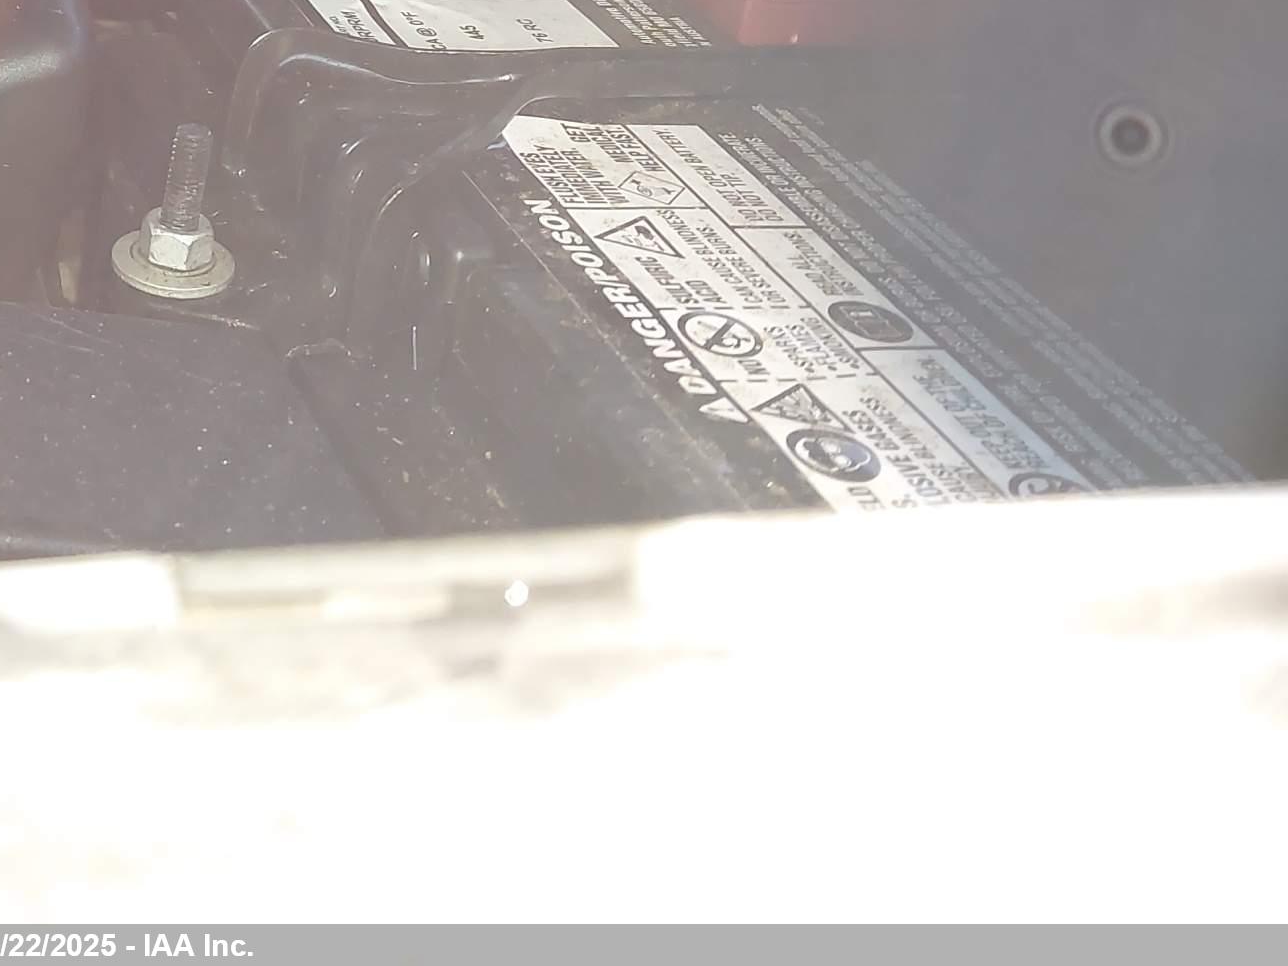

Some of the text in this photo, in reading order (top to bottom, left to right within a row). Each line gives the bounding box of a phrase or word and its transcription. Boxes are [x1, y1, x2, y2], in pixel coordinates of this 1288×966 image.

[460, 25, 485, 40] 445
[516, 18, 554, 43] 76 RC
[606, 7, 657, 45] Automotive
[650, 31, 679, 48] outh
[560, 123, 591, 142] GET
[582, 127, 634, 162] MEDICAL
[605, 127, 666, 172] HELP FAST.
[520, 152, 585, 204] FLUSH EYES
[560, 148, 630, 204] WITH WATER.
[652, 129, 764, 222] DO NOT OPEN BATTERY.
[720, 172, 784, 222] DO NOT TIP.
[656, 209, 764, 304] CAN CAUSE BLINDNESS
[726, 256, 772, 289] SEVERE
[786, 254, 818, 270] ALL
[524, 199, 718, 394] DANGER/POISON
[635, 256, 699, 304] SULFURIC
[685, 280, 728, 304] ACID
[760, 290, 787, 304] OR
[737, 360, 770, 376] NO
